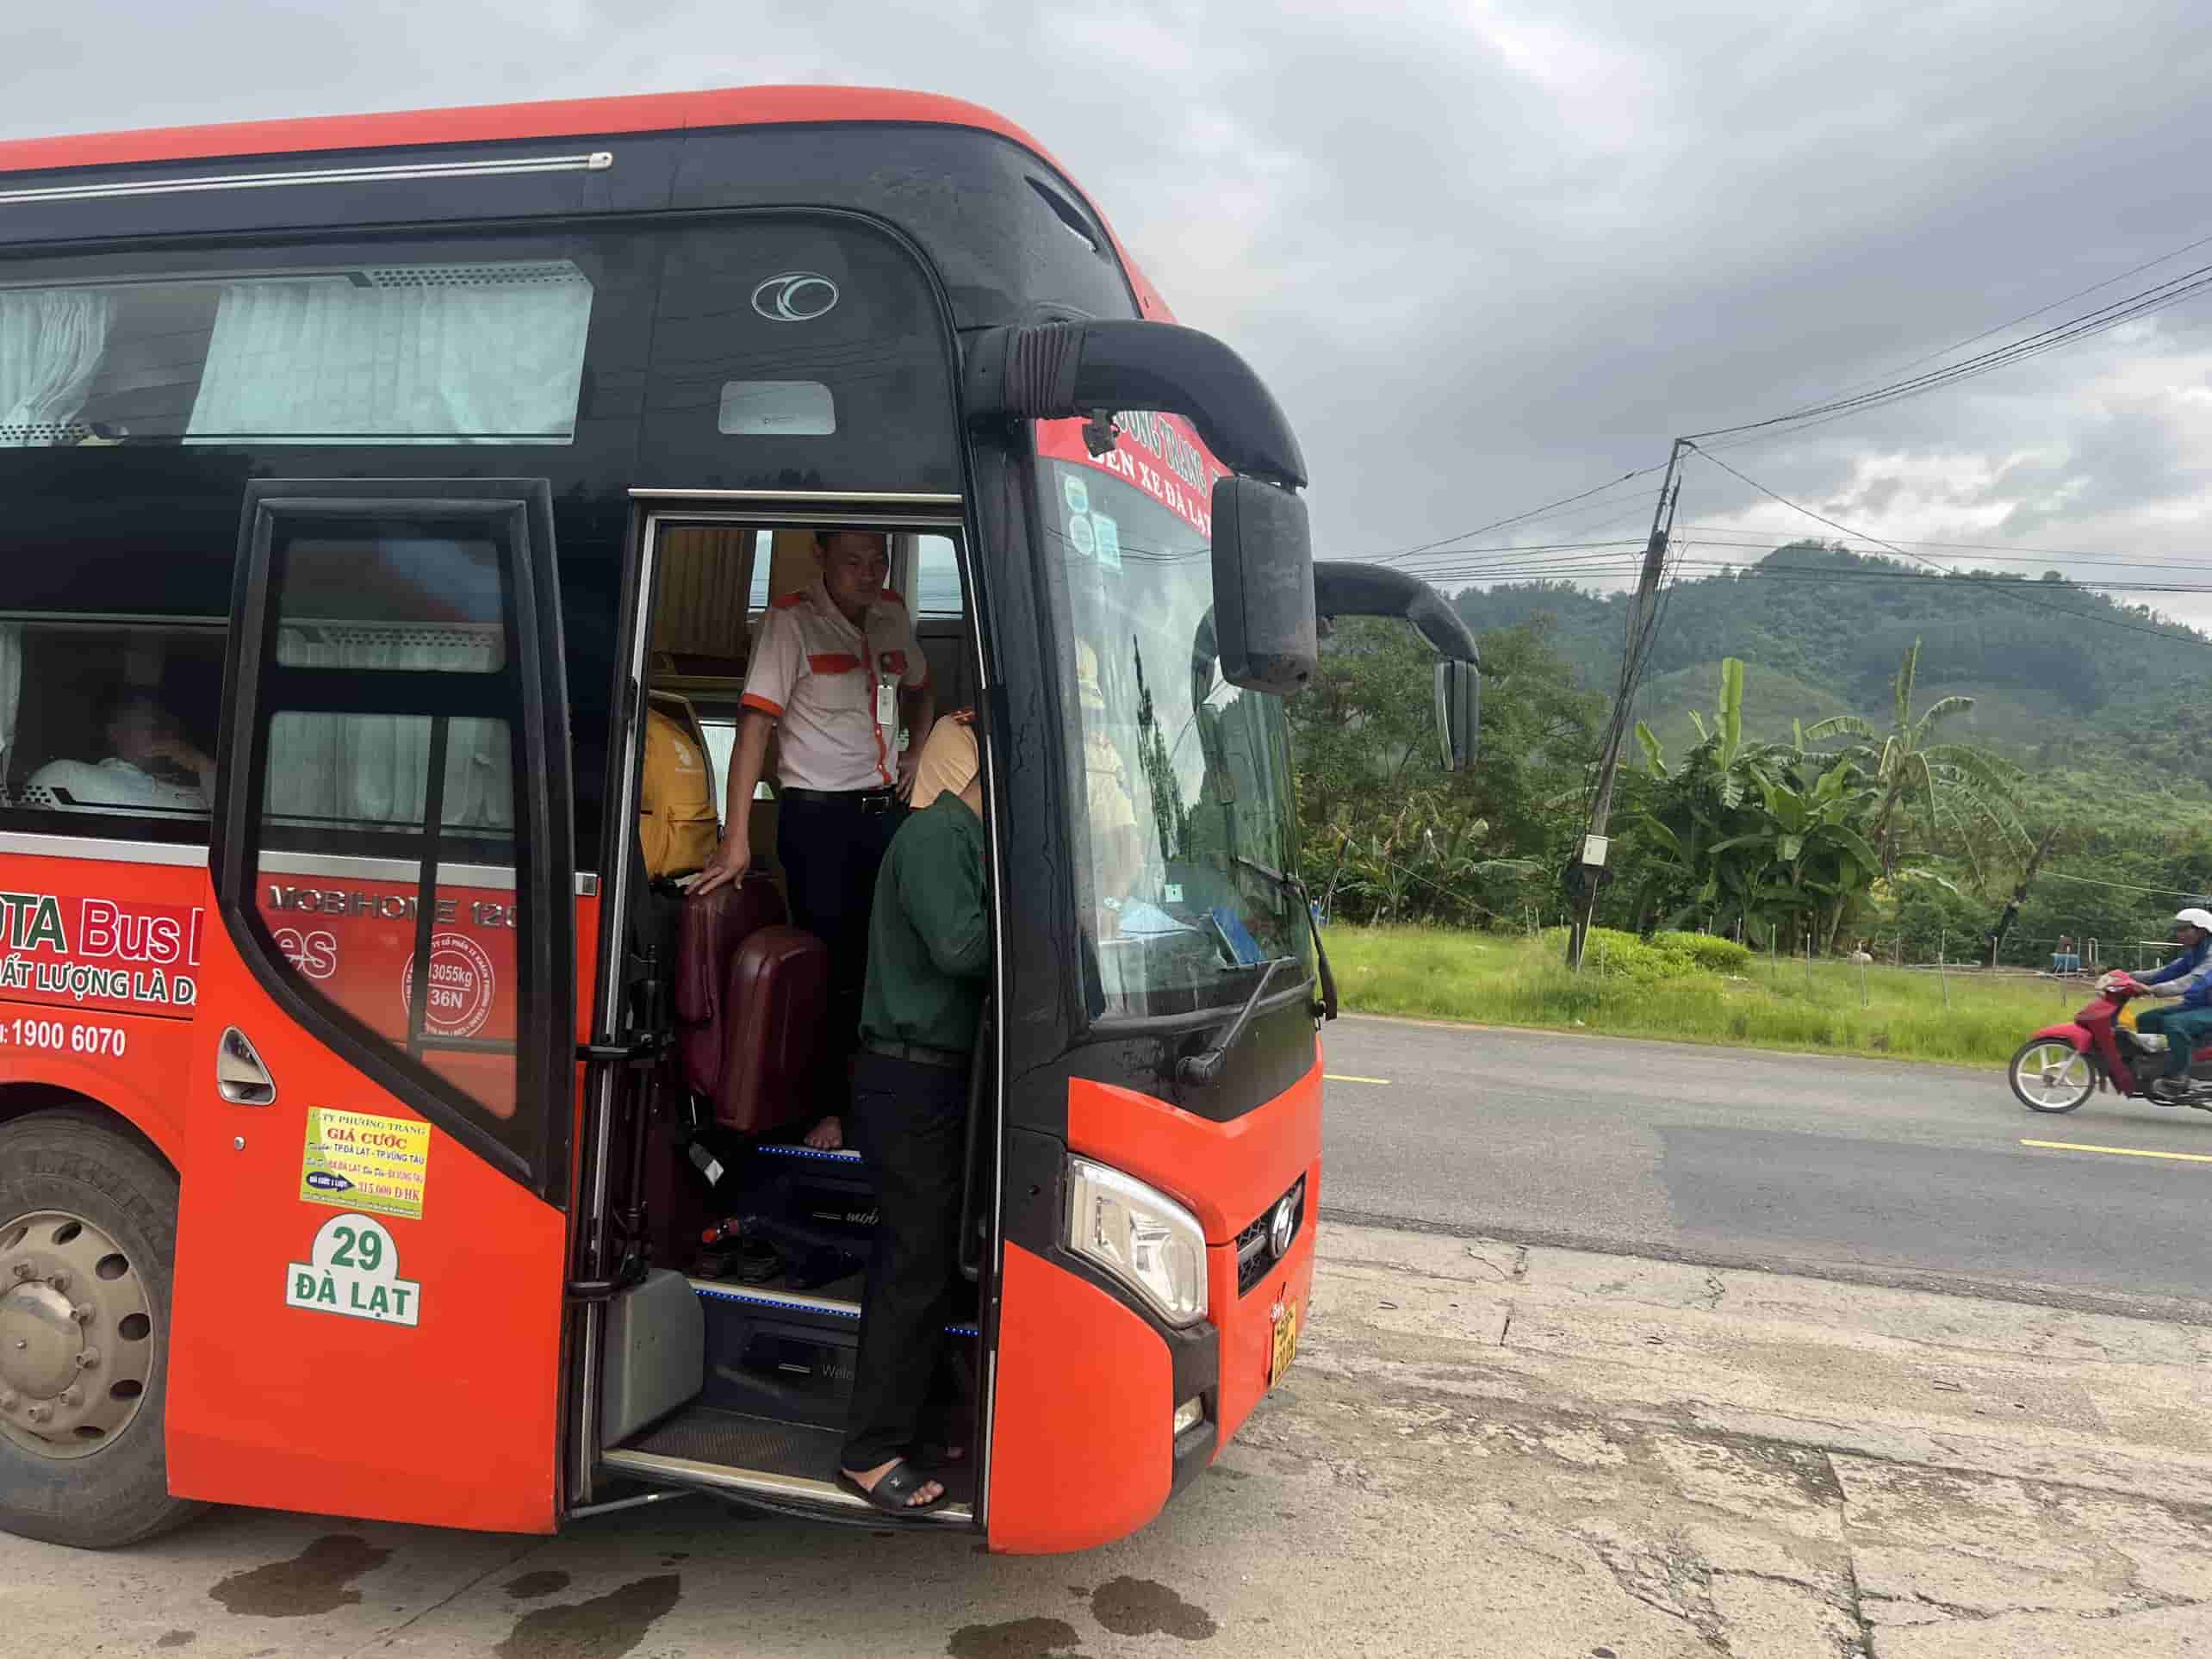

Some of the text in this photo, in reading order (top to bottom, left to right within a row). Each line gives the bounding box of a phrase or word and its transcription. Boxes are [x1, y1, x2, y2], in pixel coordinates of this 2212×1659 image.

[1138, 461, 1164, 500] XE
[0, 891, 68, 954] TA
[79, 898, 180, 964] Bus
[0, 953, 34, 988] ẤT
[36, 962, 130, 1001] LƯỢNG
[134, 967, 169, 1003] LÀ
[431, 988, 463, 1009] 36N
[12, 1018, 64, 1049] 1900
[71, 1024, 127, 1057] 6070
[331, 1226, 382, 1271] 29
[295, 1269, 411, 1317] ĐÀ LẠT
